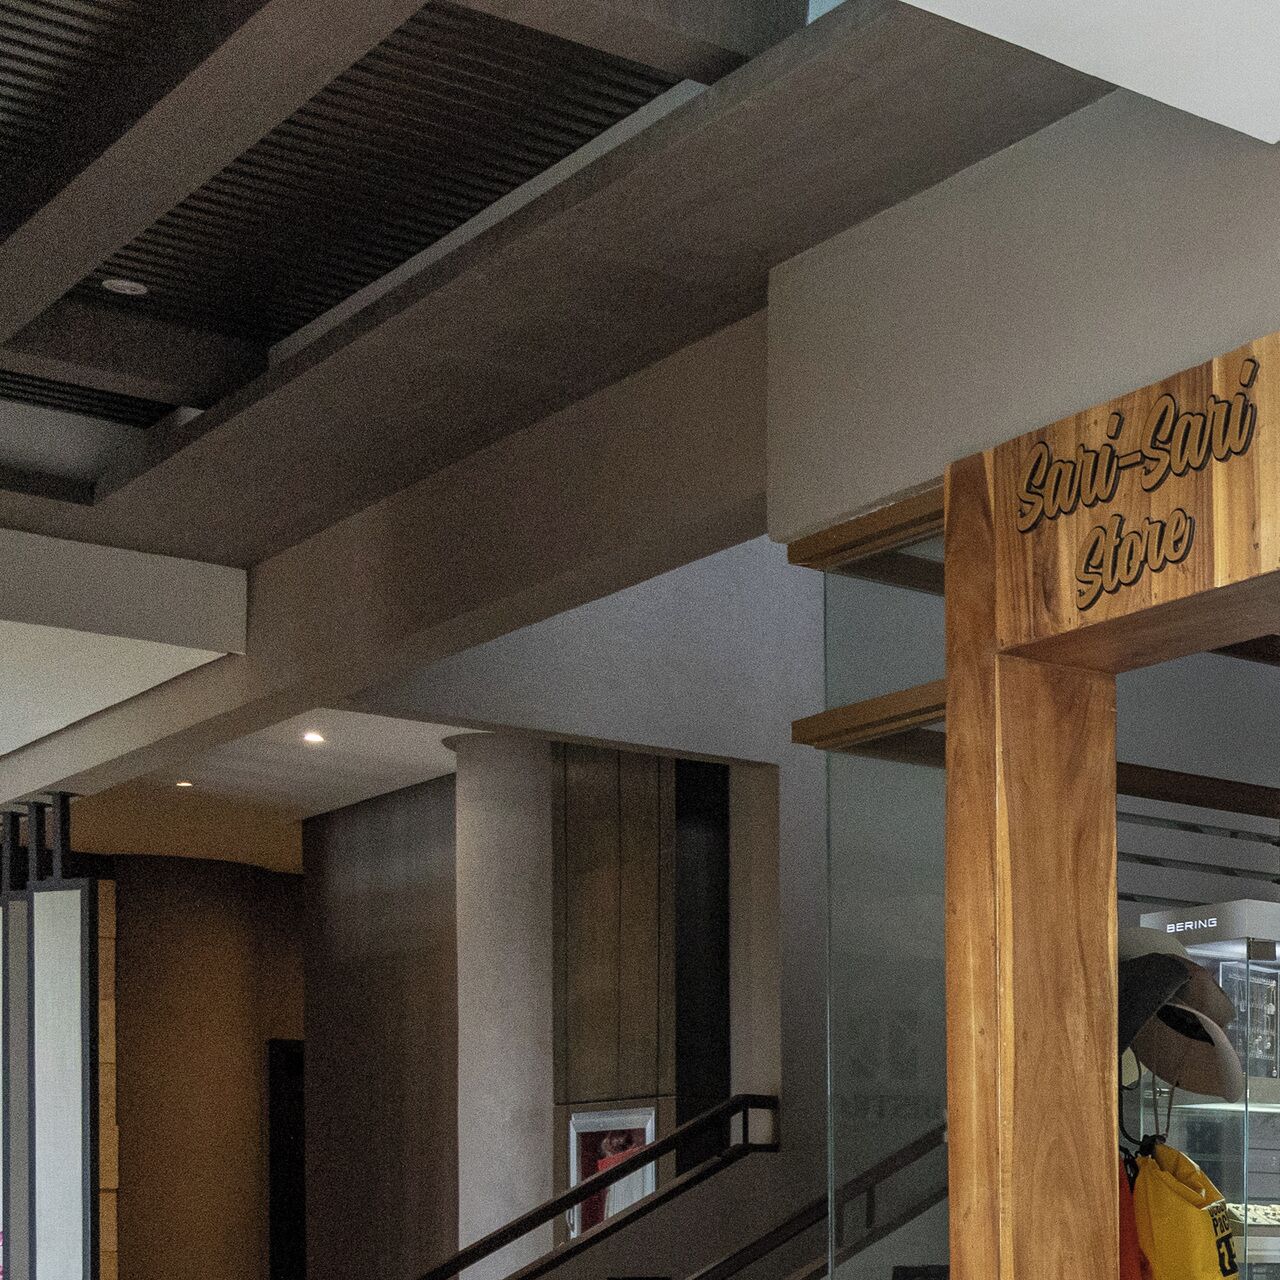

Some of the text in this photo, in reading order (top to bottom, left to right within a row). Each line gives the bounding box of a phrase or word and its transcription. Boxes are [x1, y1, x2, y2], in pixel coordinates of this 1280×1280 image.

[1016, 358, 1260, 533] Sari-Sari
[1075, 508, 1195, 611] Store
[1166, 917, 1217, 933] BERING
